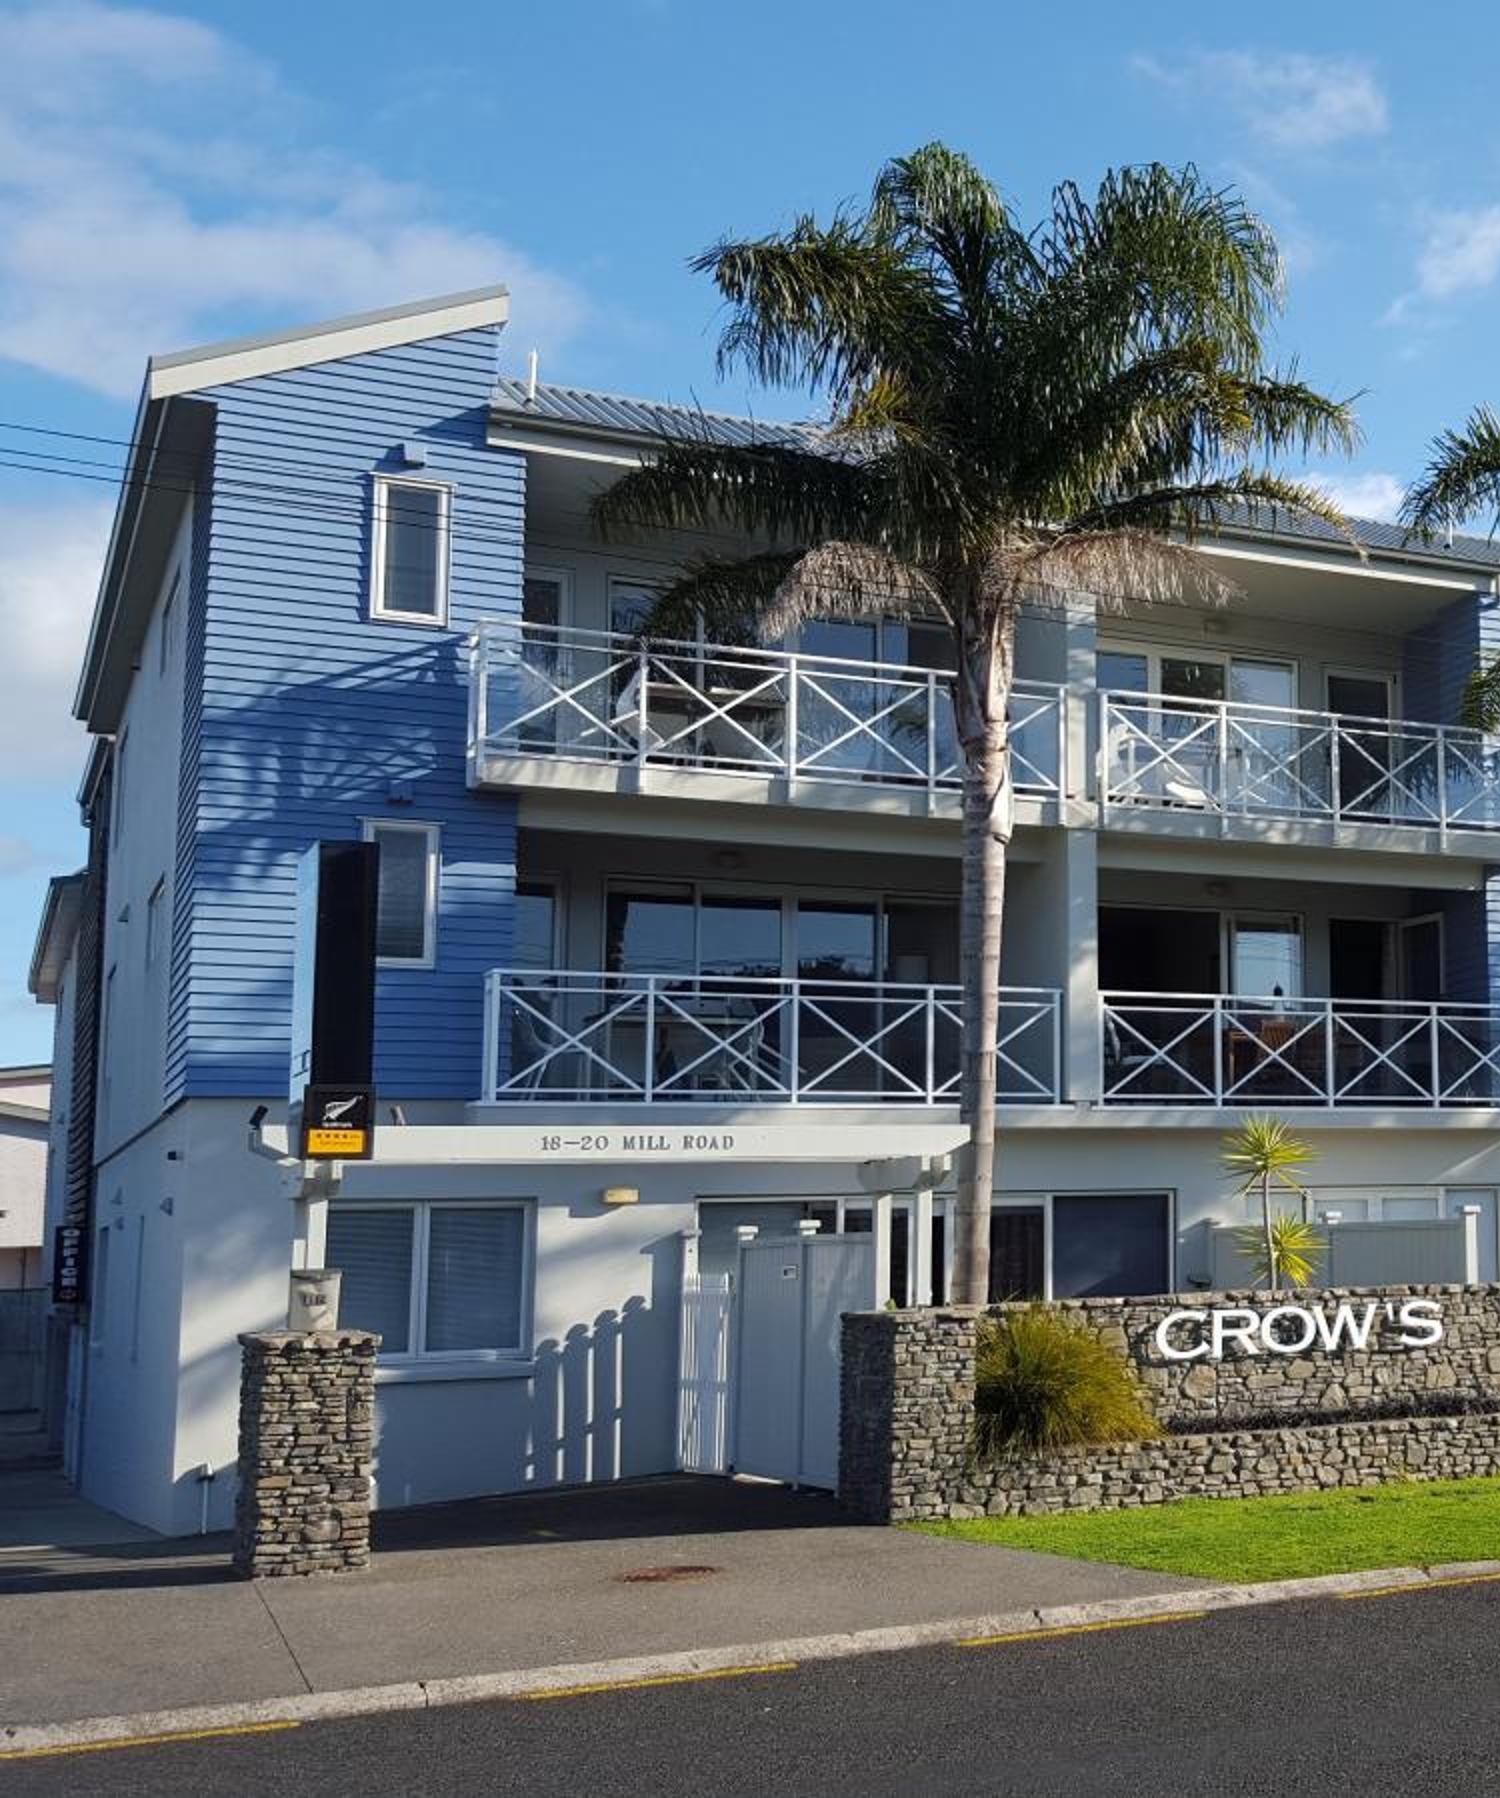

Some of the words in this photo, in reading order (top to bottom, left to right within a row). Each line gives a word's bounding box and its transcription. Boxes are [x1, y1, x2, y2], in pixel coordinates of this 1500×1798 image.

[623, 1135, 671, 1150] MILL
[683, 1135, 735, 1150] ROAD
[1155, 1301, 1443, 1360] CROW'S
